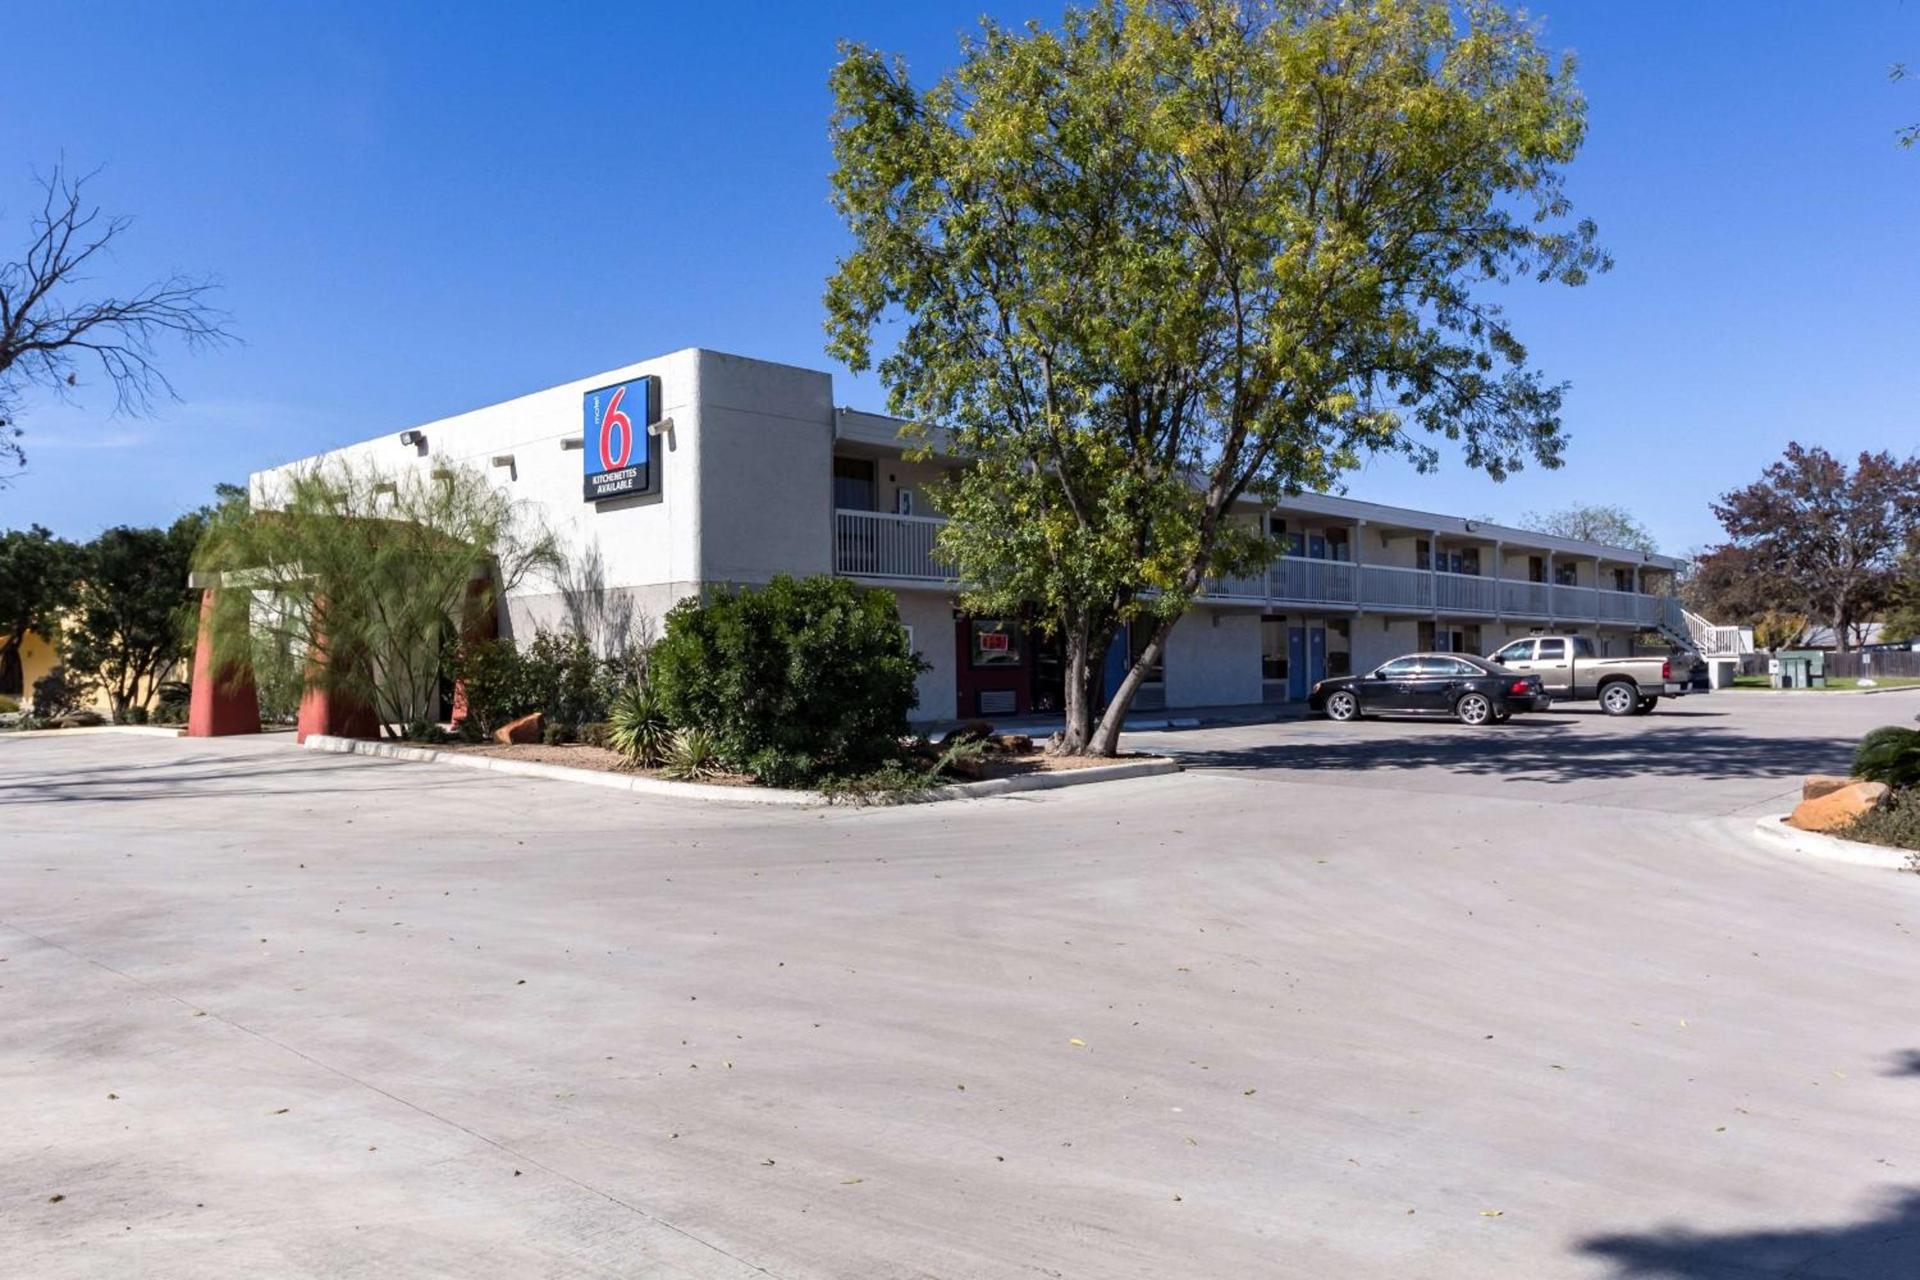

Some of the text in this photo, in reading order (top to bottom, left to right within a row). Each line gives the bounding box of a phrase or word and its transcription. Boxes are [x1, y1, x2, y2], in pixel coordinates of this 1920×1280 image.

[600, 386, 632, 471] 6
[592, 468, 637, 485] KITCHENETTES
[597, 479, 633, 494] AVAILABLE
